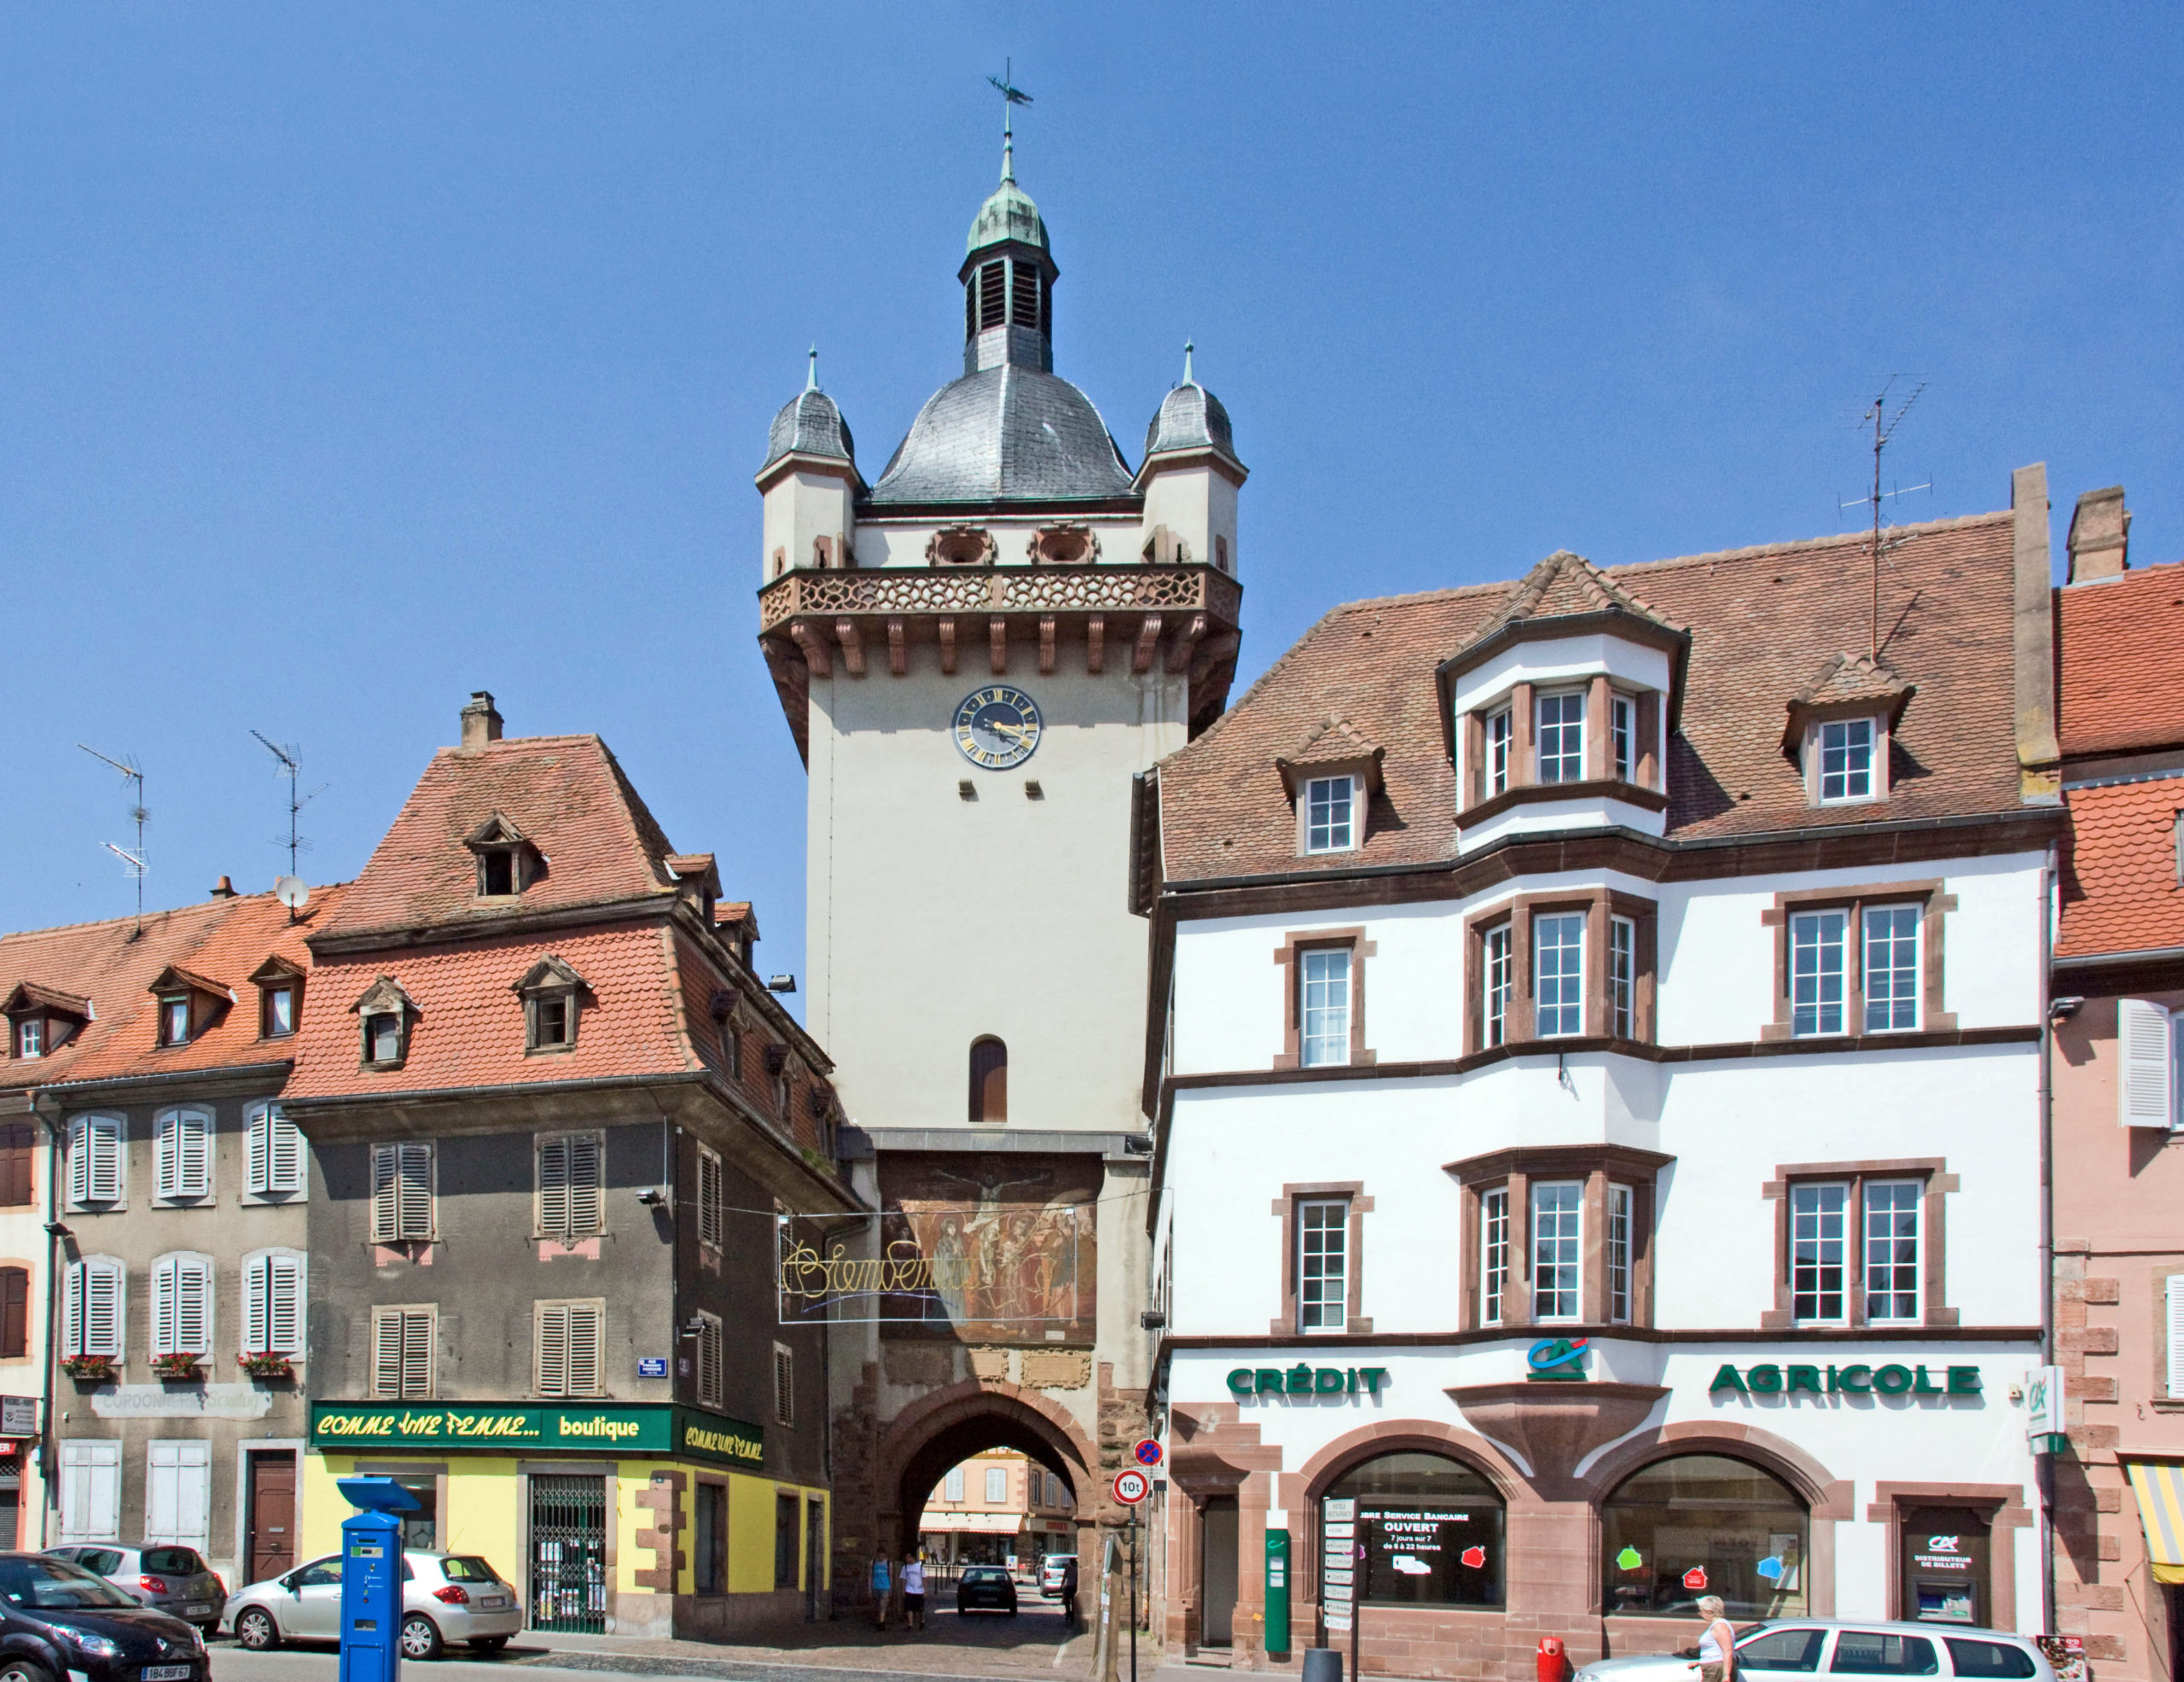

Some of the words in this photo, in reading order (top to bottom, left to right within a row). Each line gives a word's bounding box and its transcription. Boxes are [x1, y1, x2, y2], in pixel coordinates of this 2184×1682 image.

[1226, 1362, 1386, 1394] CRÉDIT
[1708, 1364, 1981, 1394] AGRICOLE
[317, 1414, 395, 1435] COMME
[398, 1411, 442, 1435] UNE
[560, 1416, 640, 1440] boutique
[686, 1426, 717, 1451] COMME
[717, 1433, 735, 1455] UNE
[1384, 1522, 1439, 1533] OUVERT
[1914, 1555, 1972, 1563] DISTRIBUTEUR
[149, 1667, 164, 1679] 184
[178, 1667, 189, 1677] 67
